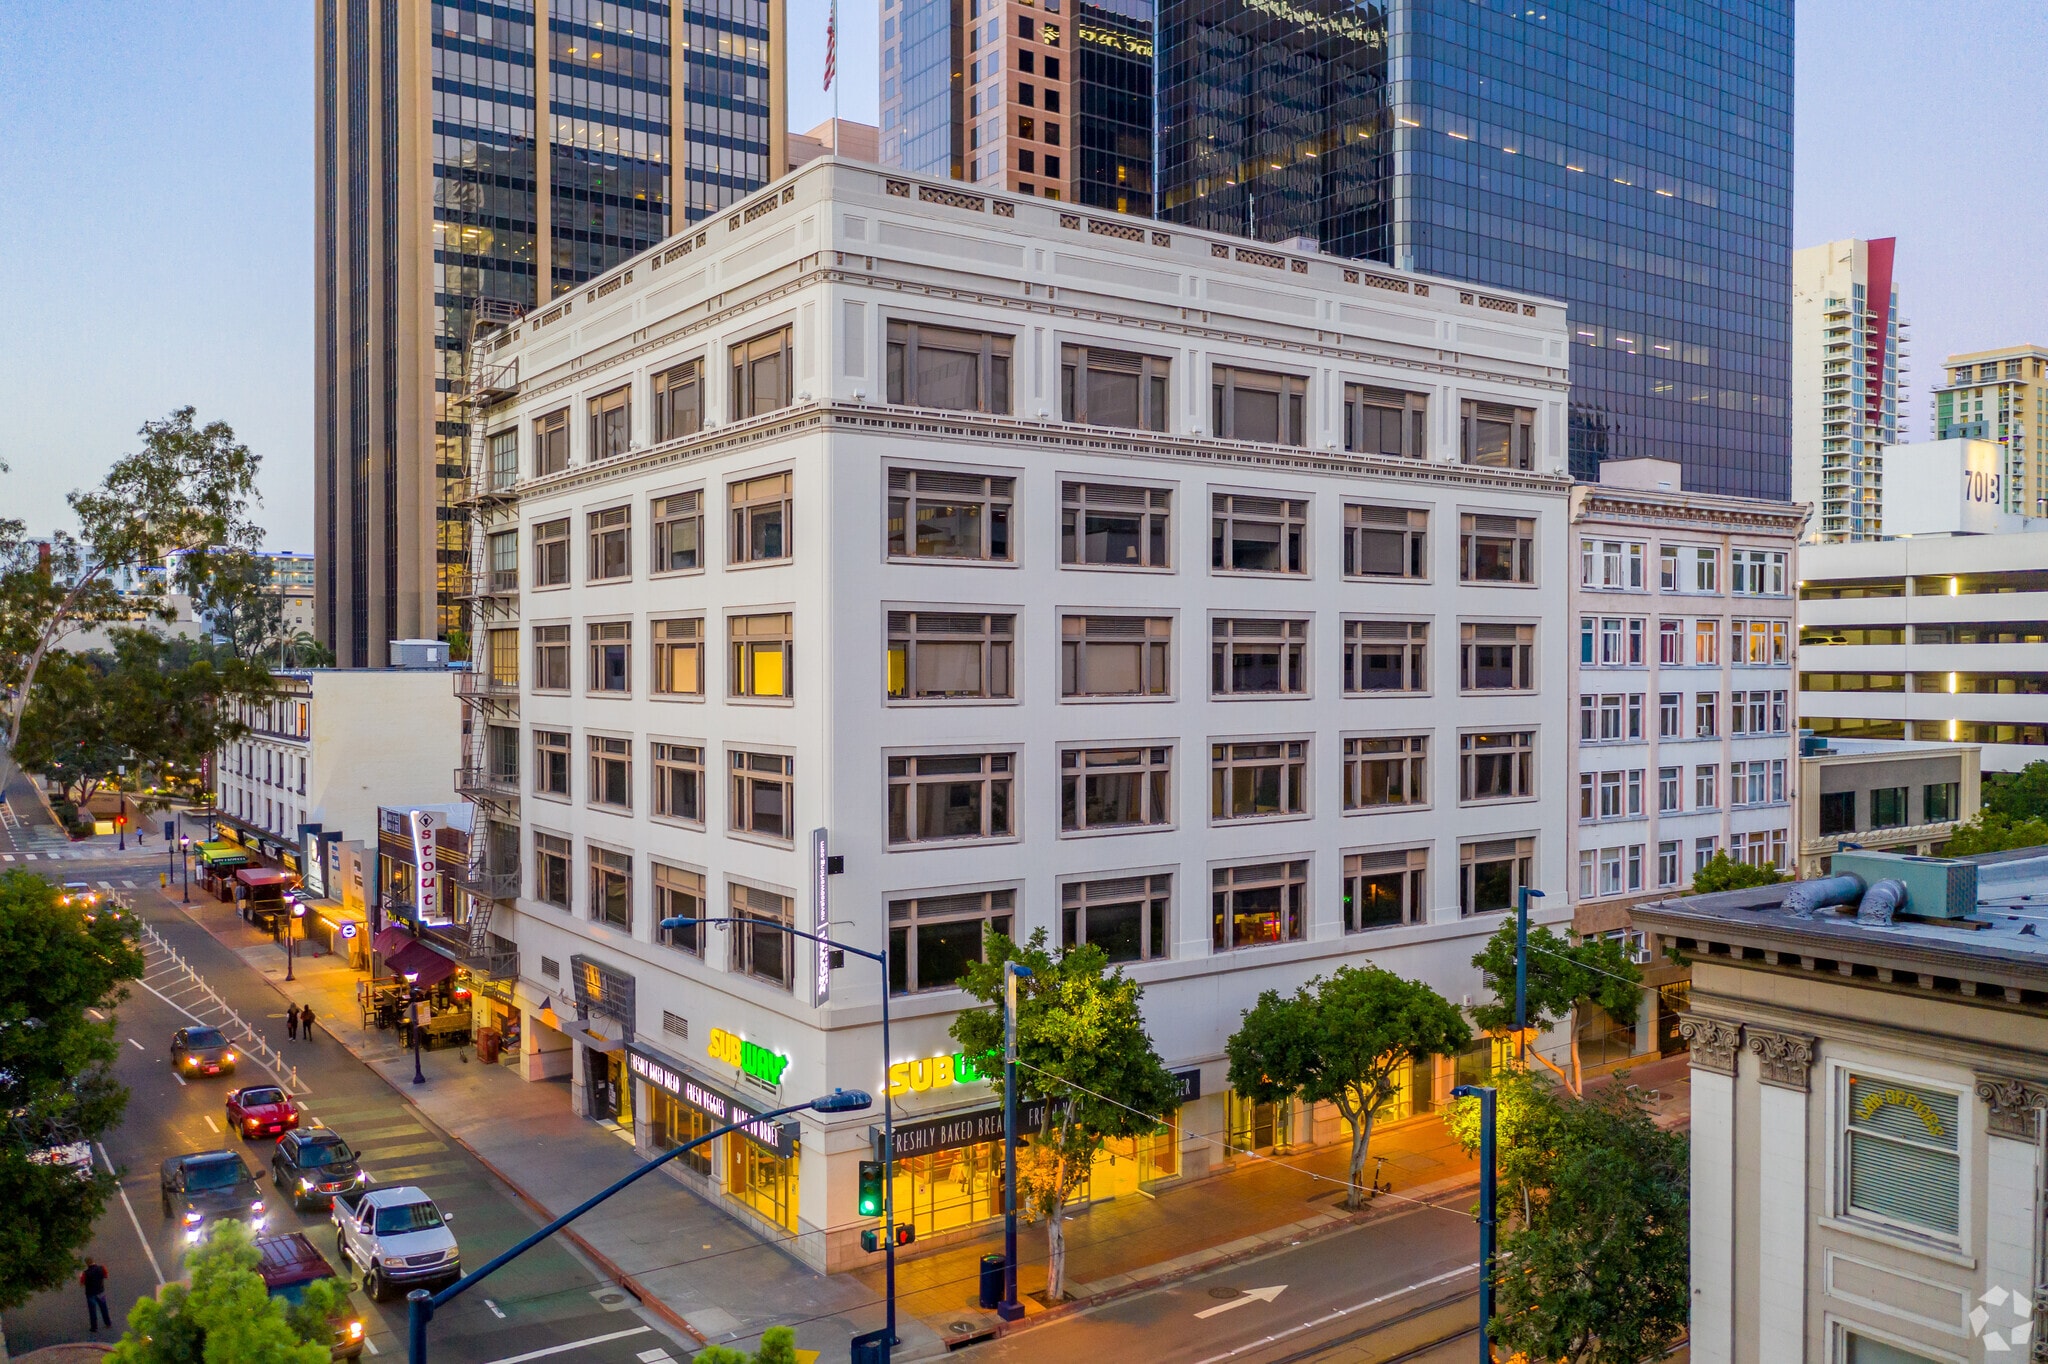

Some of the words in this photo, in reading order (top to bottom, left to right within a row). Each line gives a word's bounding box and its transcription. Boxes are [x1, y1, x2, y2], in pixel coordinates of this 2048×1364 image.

[421, 829, 435, 906] stout
[707, 1028, 789, 1086] SUBWAY
[881, 1048, 1020, 1099] SUBW
[703, 1090, 725, 1119] VEGGIES
[759, 1120, 779, 1148] ORDER
[890, 1127, 935, 1153] FRESHLY
[941, 1121, 973, 1144] BAKED
[978, 1113, 1007, 1137] BREA
[1855, 1092, 1884, 1121] LAW
[1885, 1089, 1945, 1136] OFFICES
